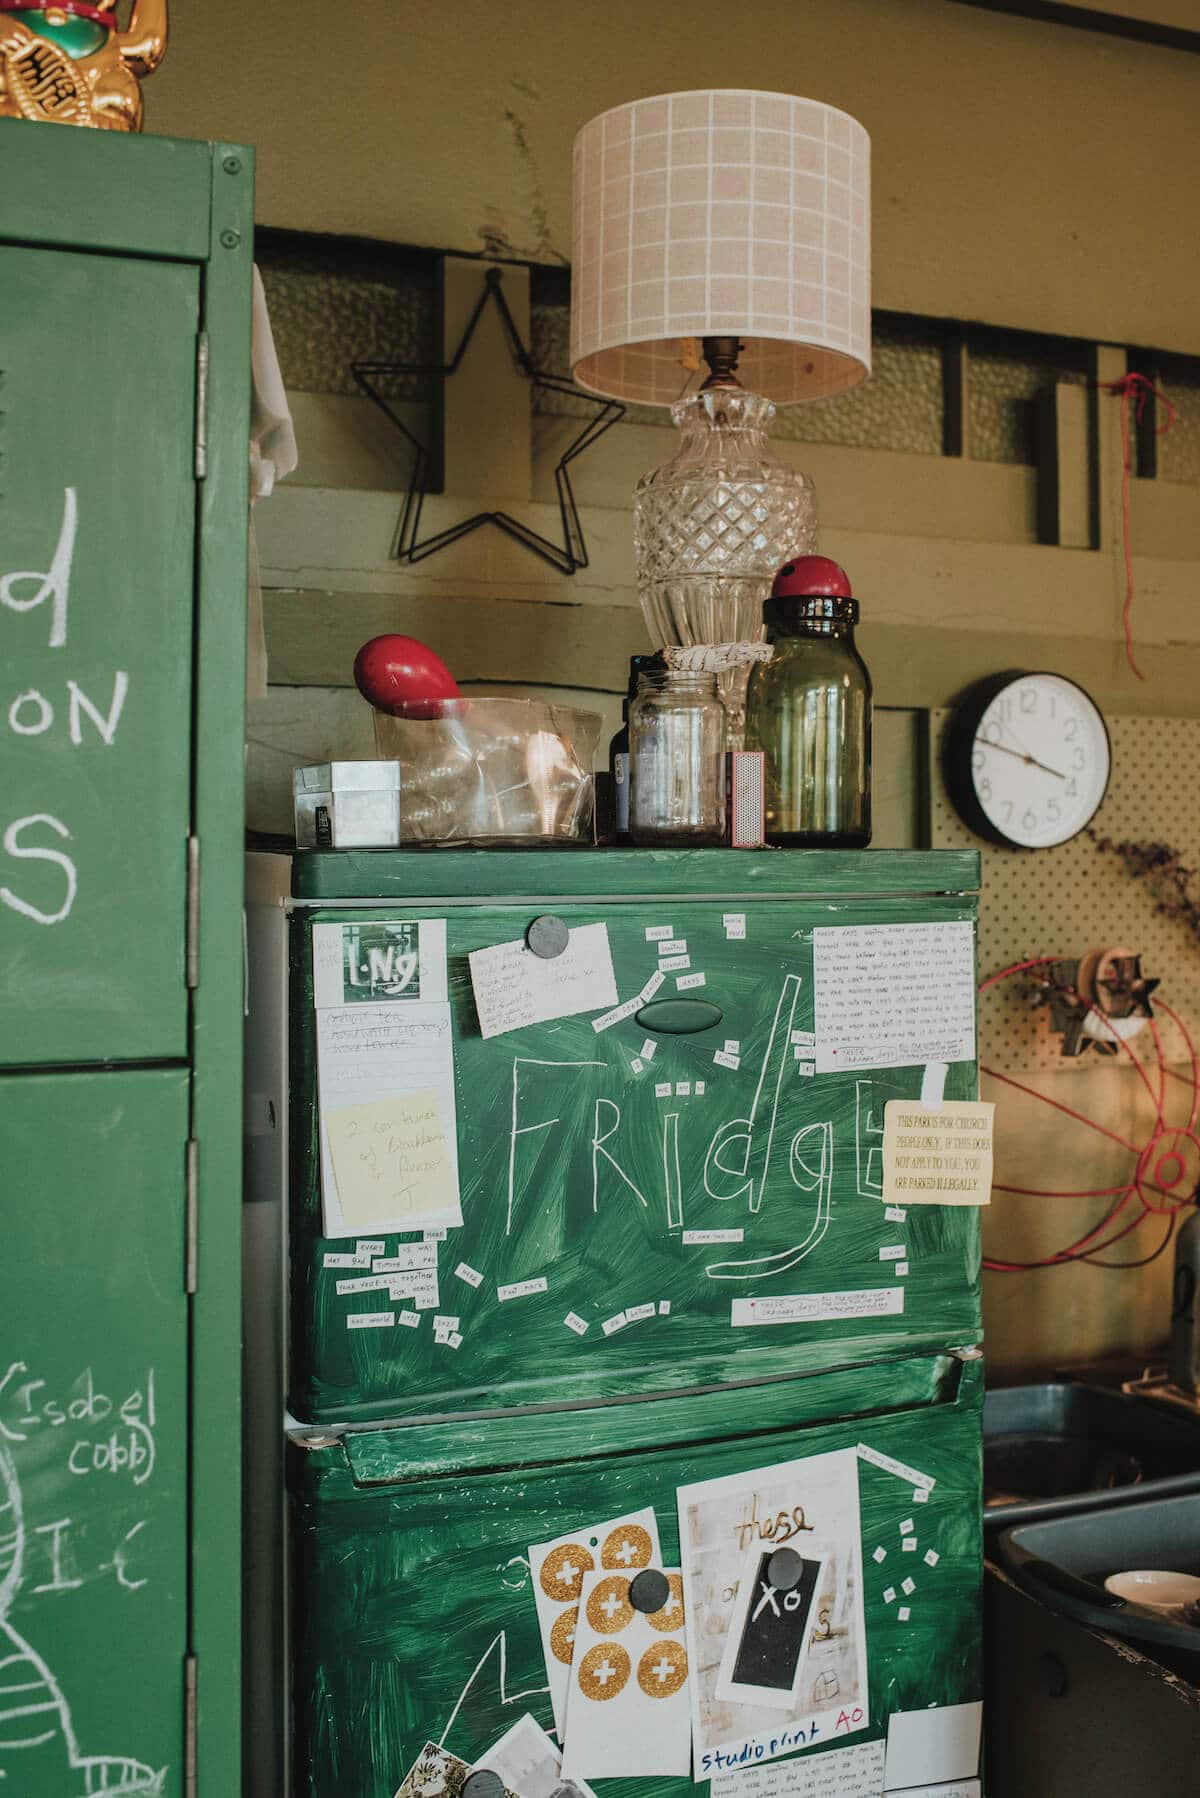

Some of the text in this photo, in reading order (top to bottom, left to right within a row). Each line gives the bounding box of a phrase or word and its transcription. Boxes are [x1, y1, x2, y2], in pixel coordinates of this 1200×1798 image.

[1020, 689, 1037, 714] 12
[1064, 718, 1078, 742] 2
[973, 751, 986, 773] 9
[1073, 747, 1085, 771] 3
[981, 777, 992, 802] 8
[1064, 776, 1077, 797] 4
[1001, 801, 1015, 824] 7
[1022, 808, 1037, 830] 6
[1047, 799, 1061, 822] 5
[897, 1115, 913, 1128] THIS
[939, 1115, 954, 1129] FOR
[896, 1135, 920, 1149] PEOPLE
[954, 1137, 972, 1149] THIS
[972, 1138, 990, 1150] DOES
[895, 1156, 910, 1168] NOT
[910, 1156, 931, 1168] APPLY
[932, 1156, 943, 1168] TO
[964, 1158, 979, 1170] YOU
[895, 1177, 908, 1190] ARE
[909, 1177, 936, 1190] PARKED
